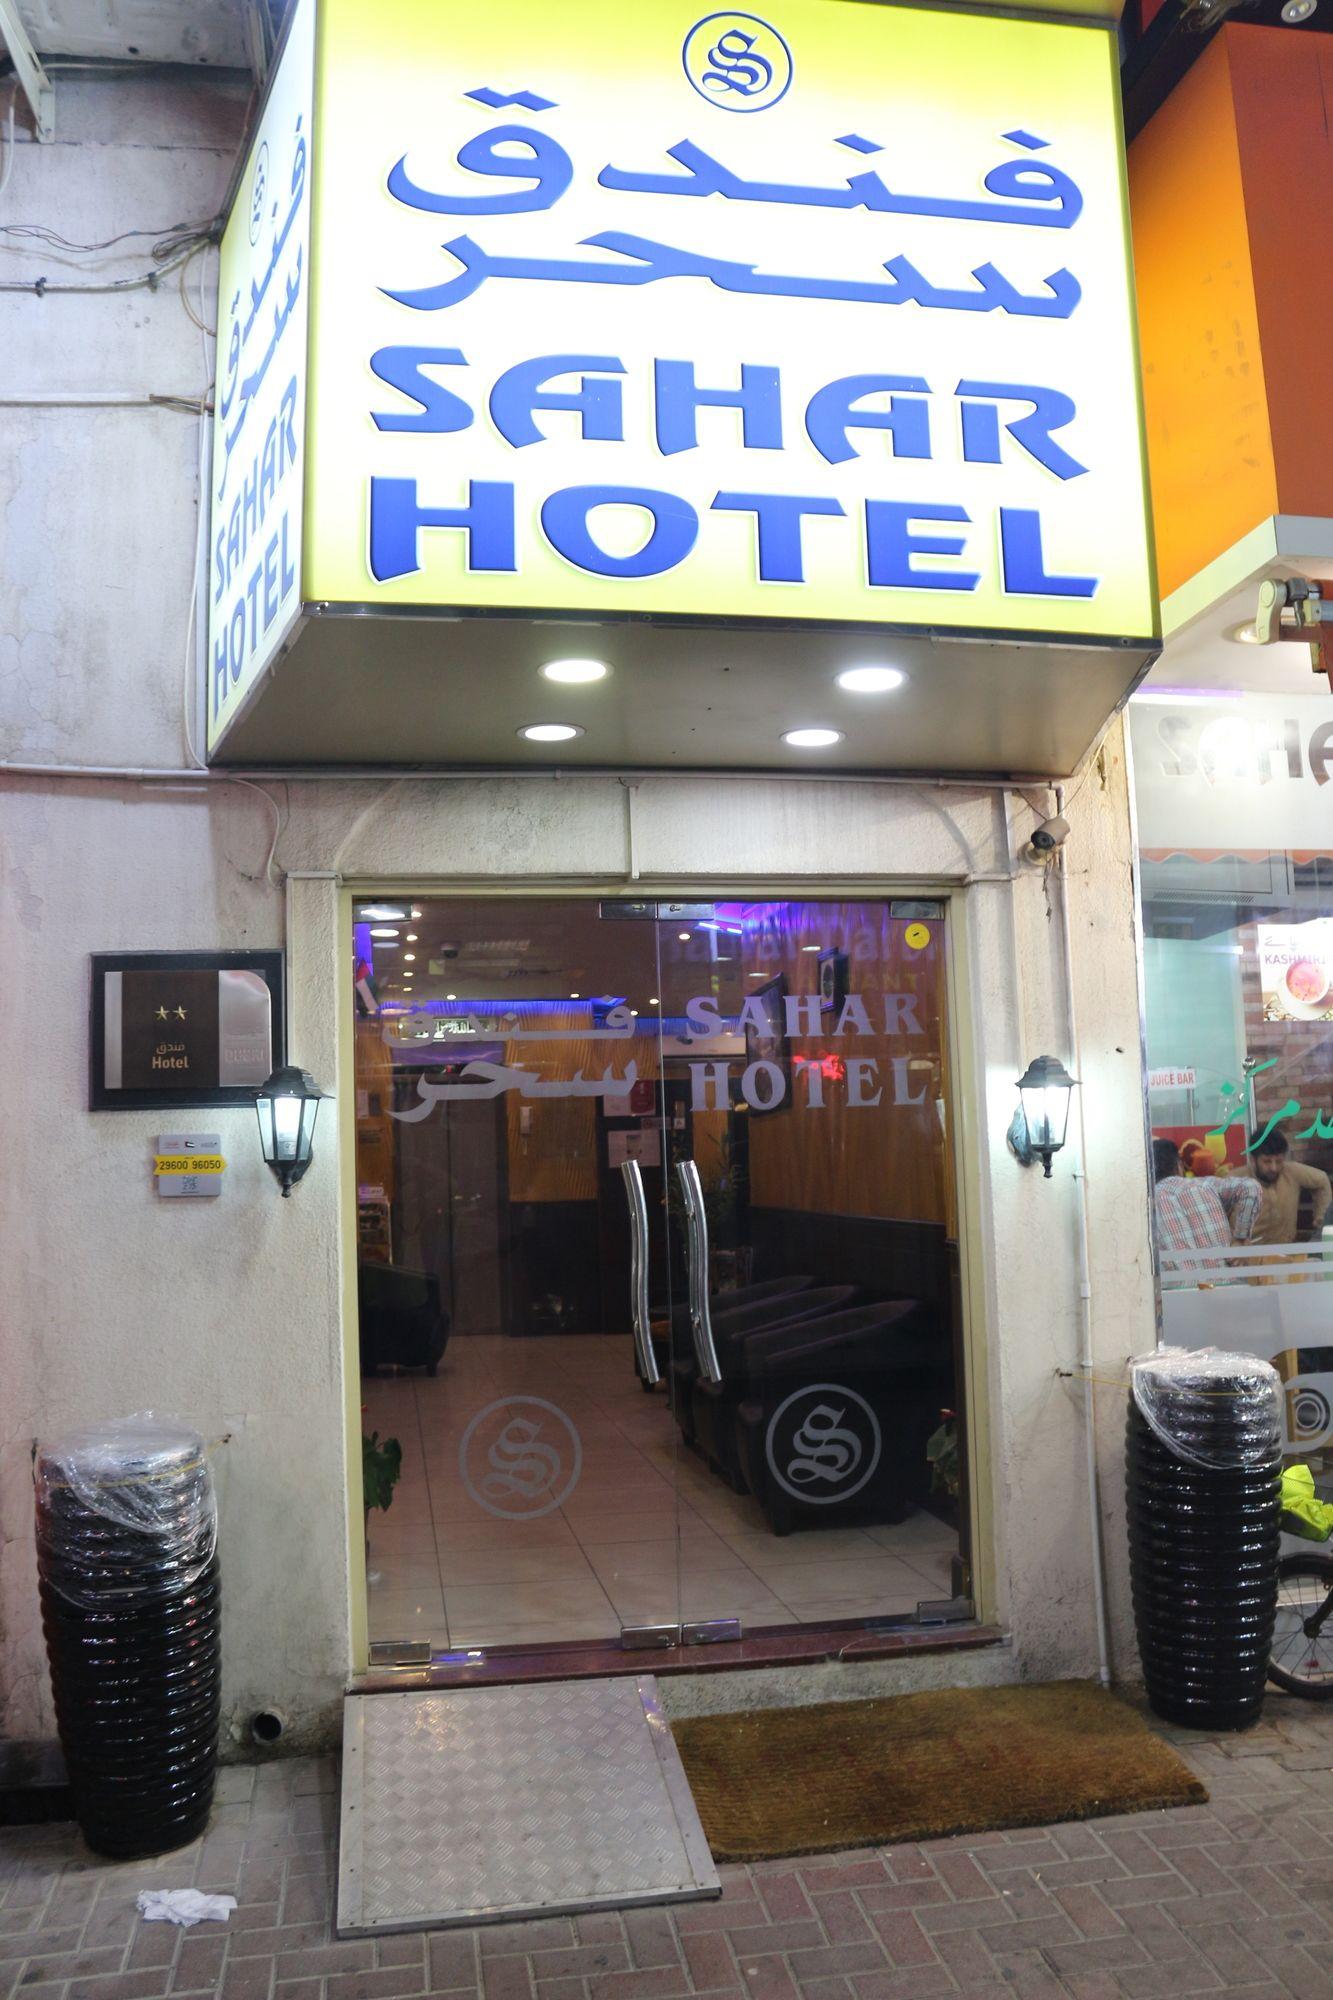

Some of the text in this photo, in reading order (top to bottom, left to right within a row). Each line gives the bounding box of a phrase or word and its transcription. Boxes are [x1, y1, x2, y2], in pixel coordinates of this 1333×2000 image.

[386, 86, 1085, 230] فندق
[376, 230, 1084, 319] سحر
[369, 345, 1091, 482] SAHAR
[215, 374, 298, 606] SAHAR
[369, 475, 1101, 598] HOTEL
[213, 507, 296, 721] HOTEL
[382, 994, 637, 1048] فندق
[685, 993, 924, 1040] SAHAR
[152, 1055, 189, 1069] Hotel
[384, 1059, 638, 1123] سحر
[688, 1057, 928, 1112] HOTEL
[1151, 1072, 1194, 1087] JUICE BAR
[160, 1160, 221, 1170] 29600 96050
